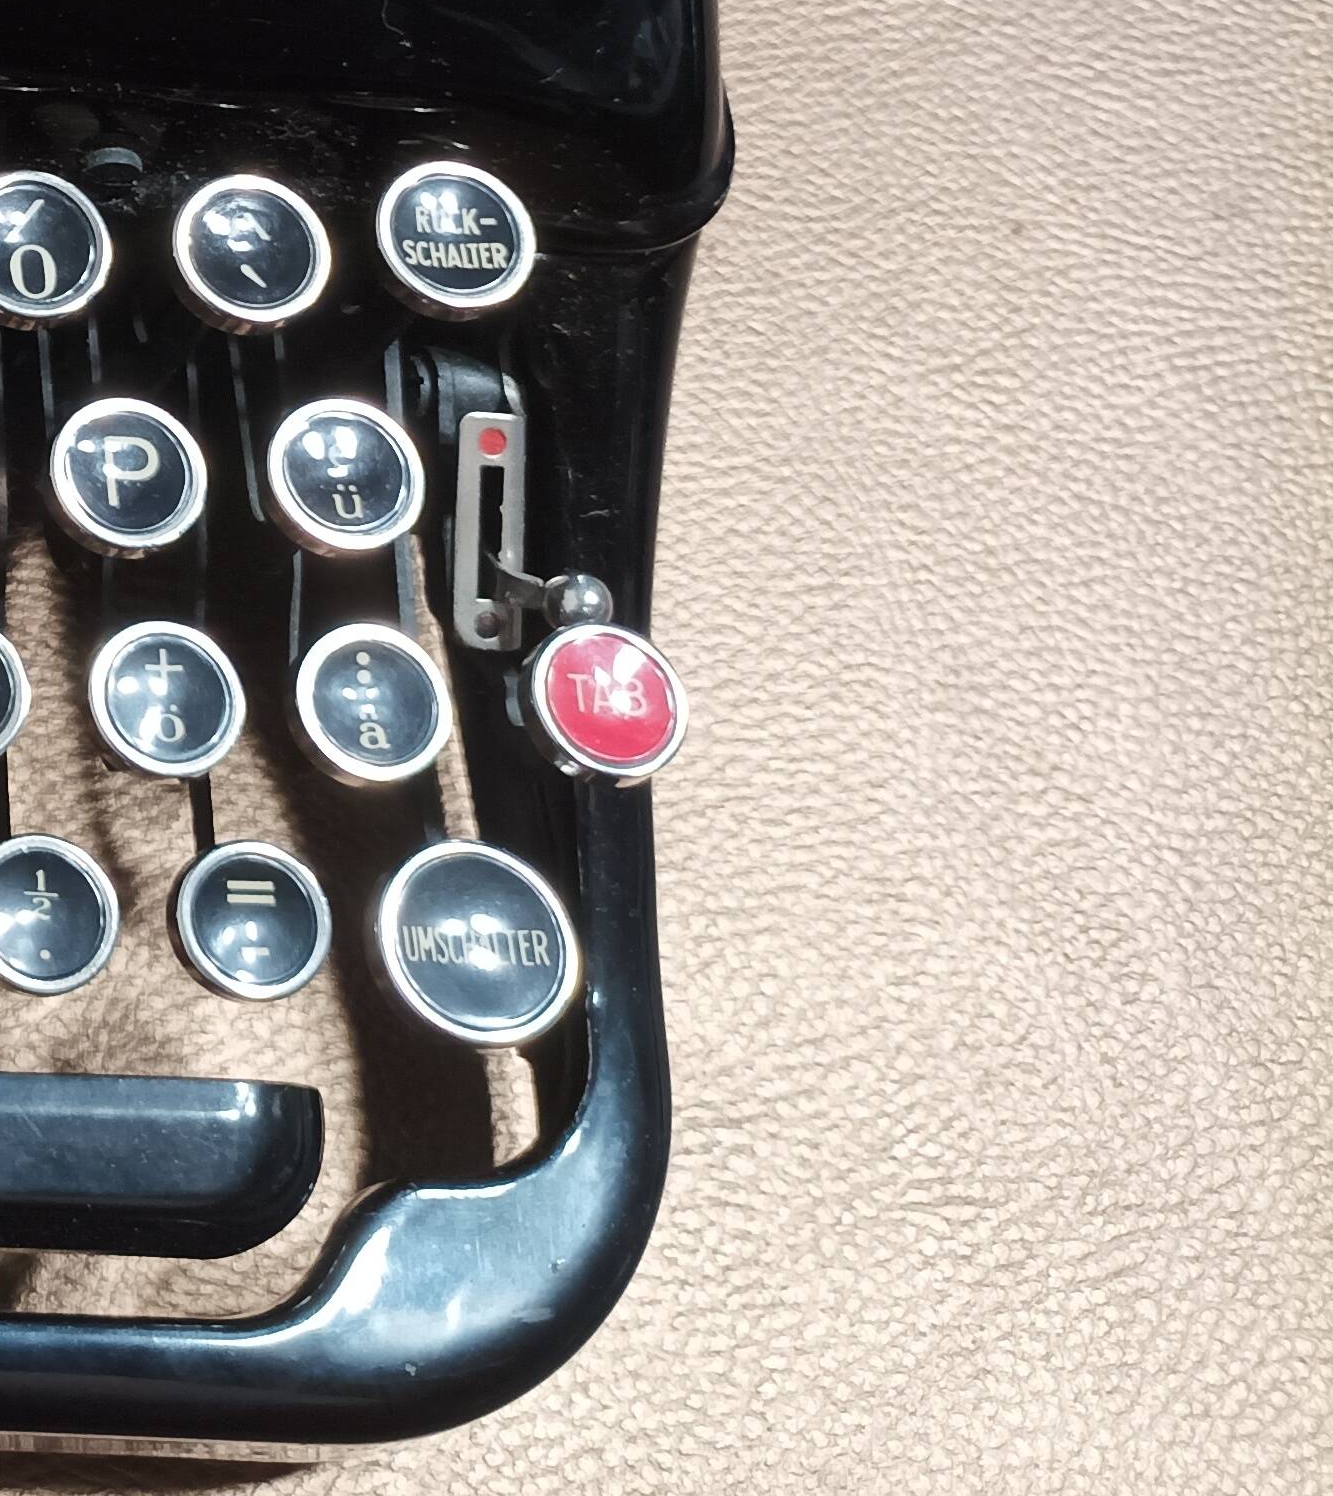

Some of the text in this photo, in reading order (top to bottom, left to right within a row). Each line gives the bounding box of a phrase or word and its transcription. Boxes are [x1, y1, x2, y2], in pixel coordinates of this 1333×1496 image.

[415, 205, 497, 236] RK-
[9, 244, 57, 299] 0
[402, 240, 508, 269] SCHALTER
[104, 436, 160, 507] P
[332, 484, 363, 518] ü
[566, 673, 648, 716] TAB
